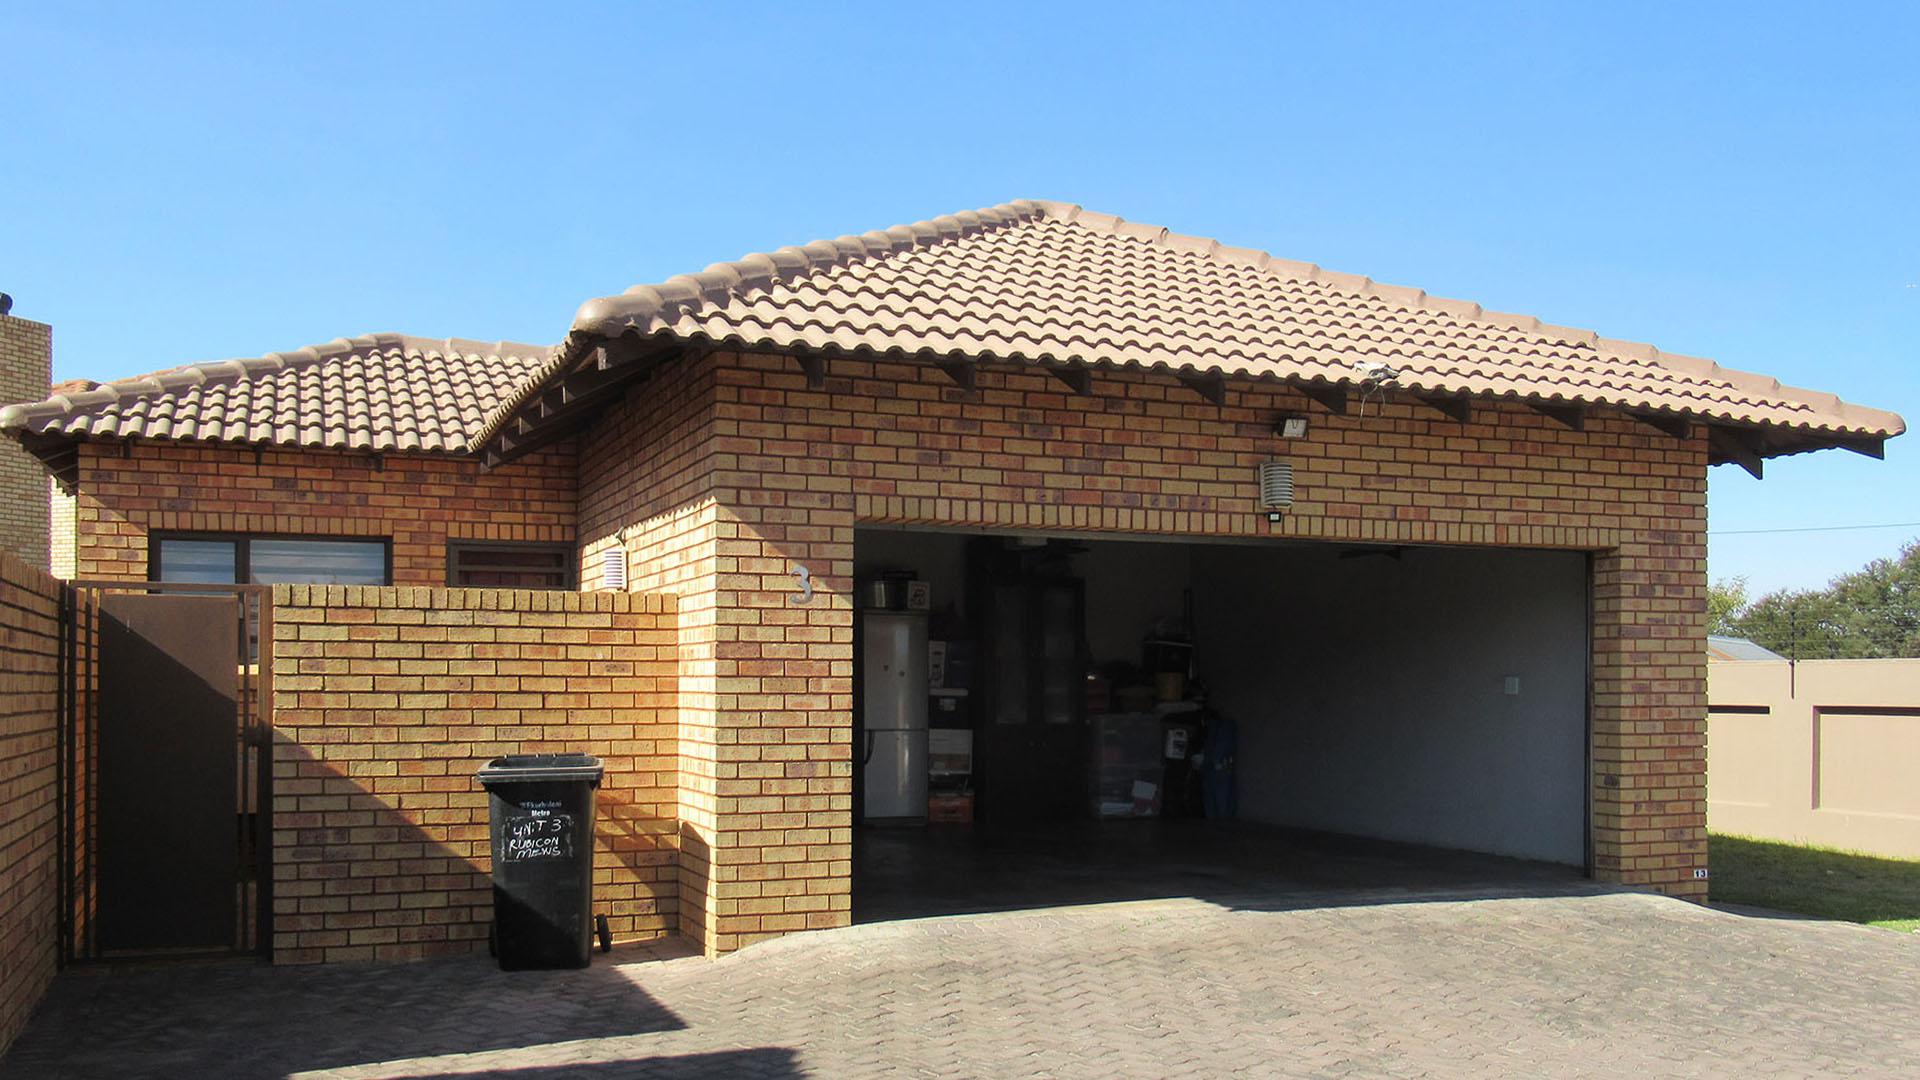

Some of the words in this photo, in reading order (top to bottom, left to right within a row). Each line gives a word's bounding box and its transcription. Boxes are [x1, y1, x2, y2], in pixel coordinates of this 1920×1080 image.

[790, 564, 813, 604] 3
[531, 809, 551, 817] Metro
[551, 818, 562, 832] 3
[509, 836, 559, 852] RUBICON
[516, 846, 561, 859] MEWS
[1695, 870, 1706, 878] 13
